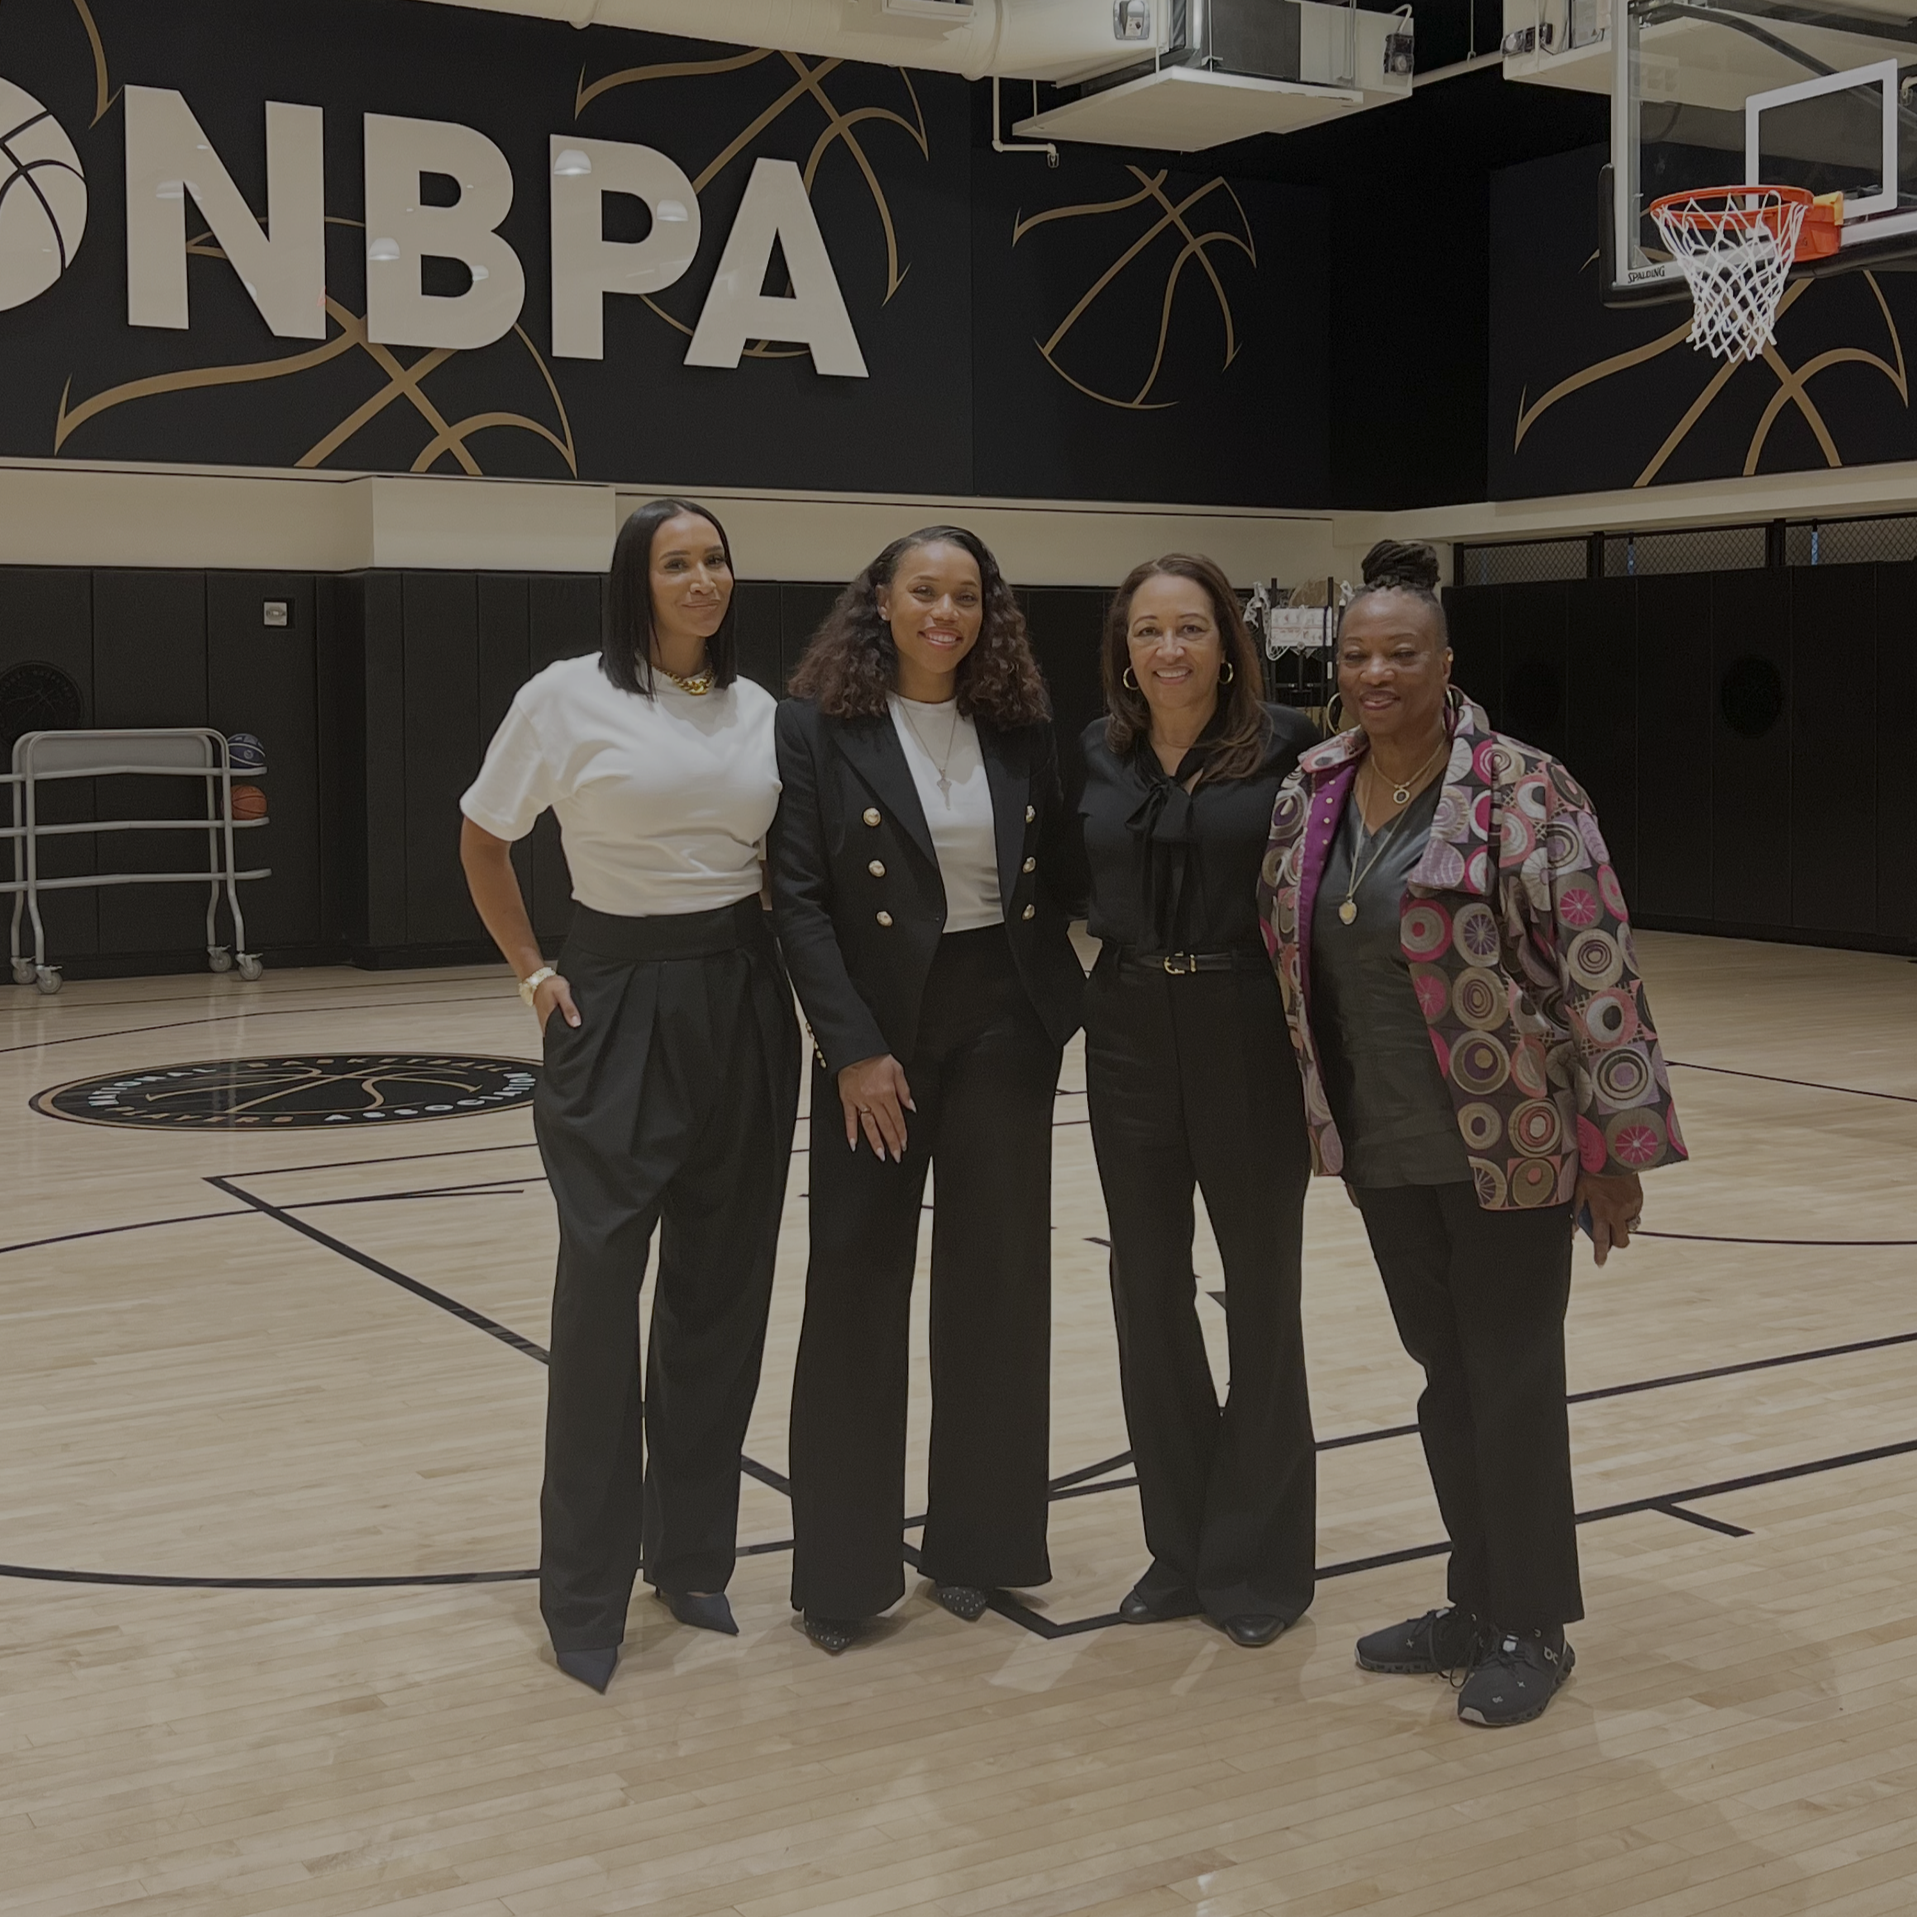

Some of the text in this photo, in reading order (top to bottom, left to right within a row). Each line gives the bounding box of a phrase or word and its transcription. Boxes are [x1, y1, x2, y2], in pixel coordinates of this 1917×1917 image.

[124, 84, 871, 379] NBPA
[1627, 265, 1666, 284] SPALDING
[87, 1068, 218, 1107] NATIONAL
[103, 1071, 537, 1124] PLAYERS ASSOCIATION
